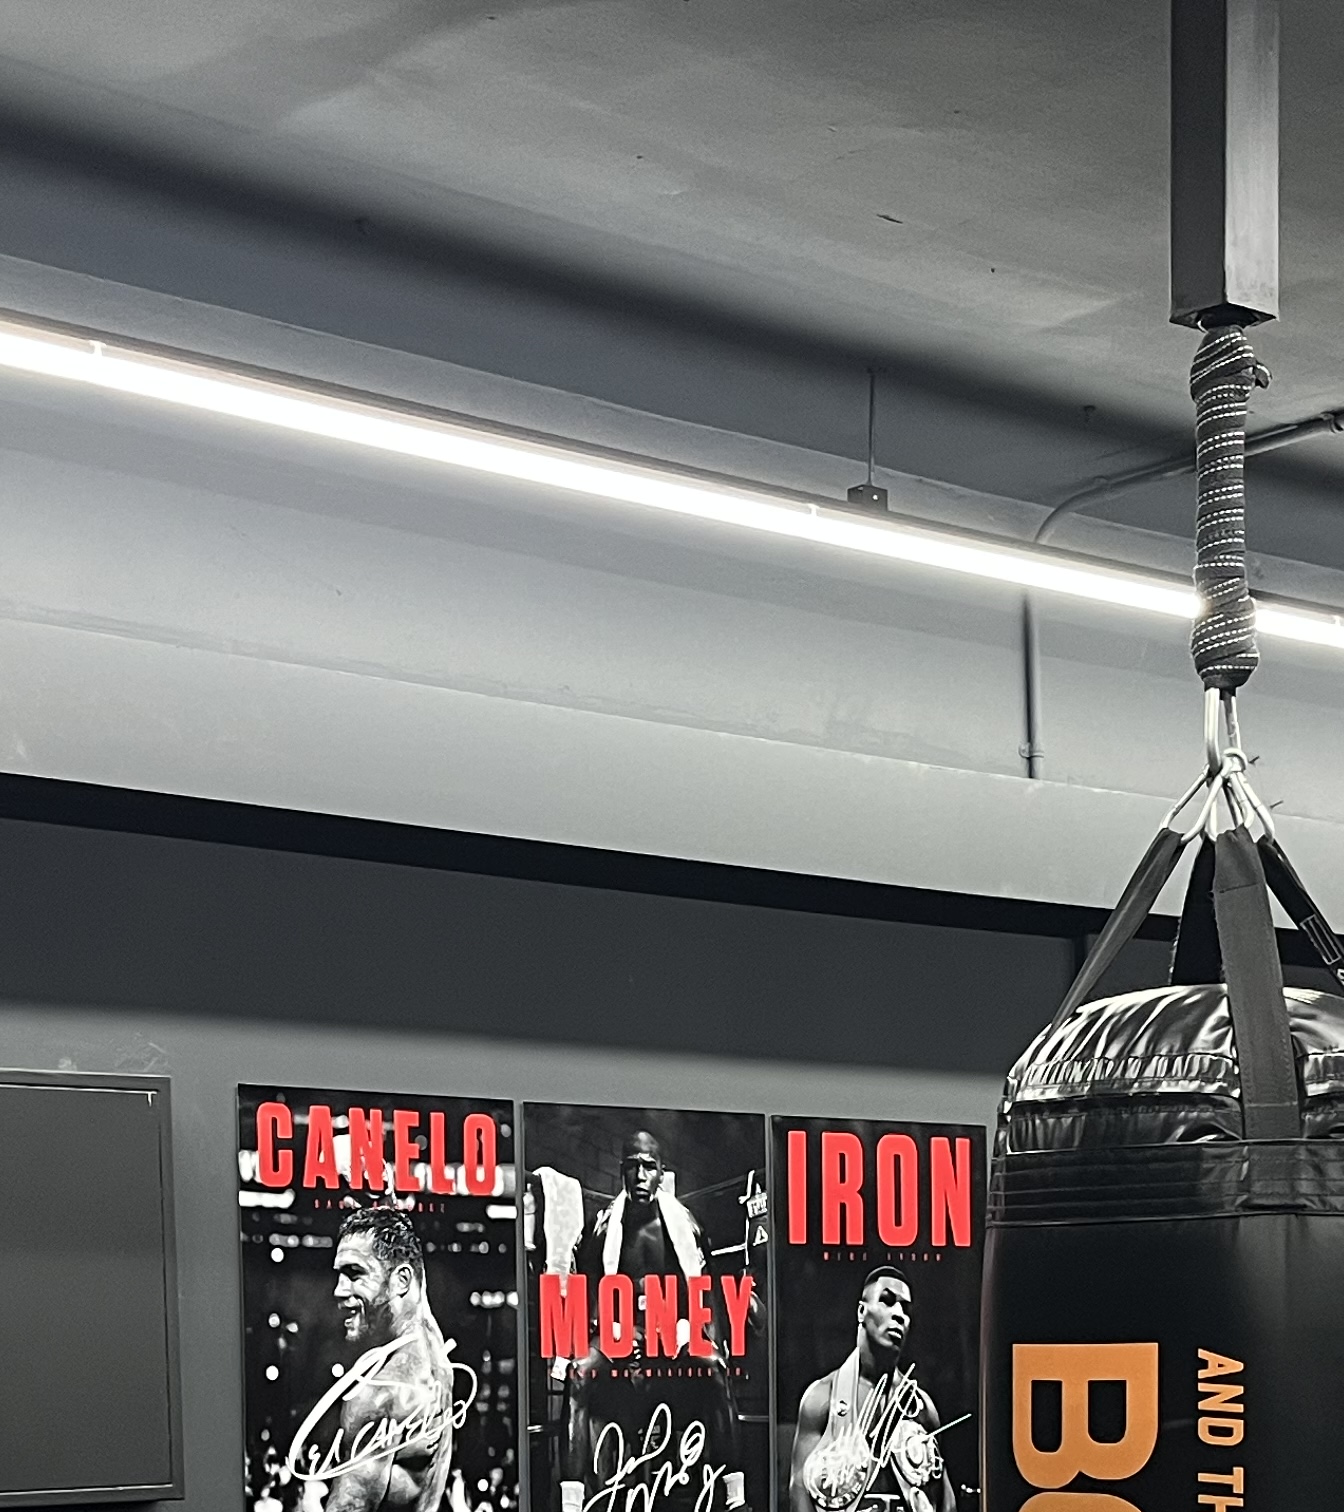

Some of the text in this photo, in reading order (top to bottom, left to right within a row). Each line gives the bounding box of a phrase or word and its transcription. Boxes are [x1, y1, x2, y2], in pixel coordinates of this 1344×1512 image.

[256, 1101, 497, 1196] CANELO
[787, 1130, 971, 1247] IRON
[539, 1273, 753, 1359] MONEY
[1197, 1348, 1244, 1446] AND
